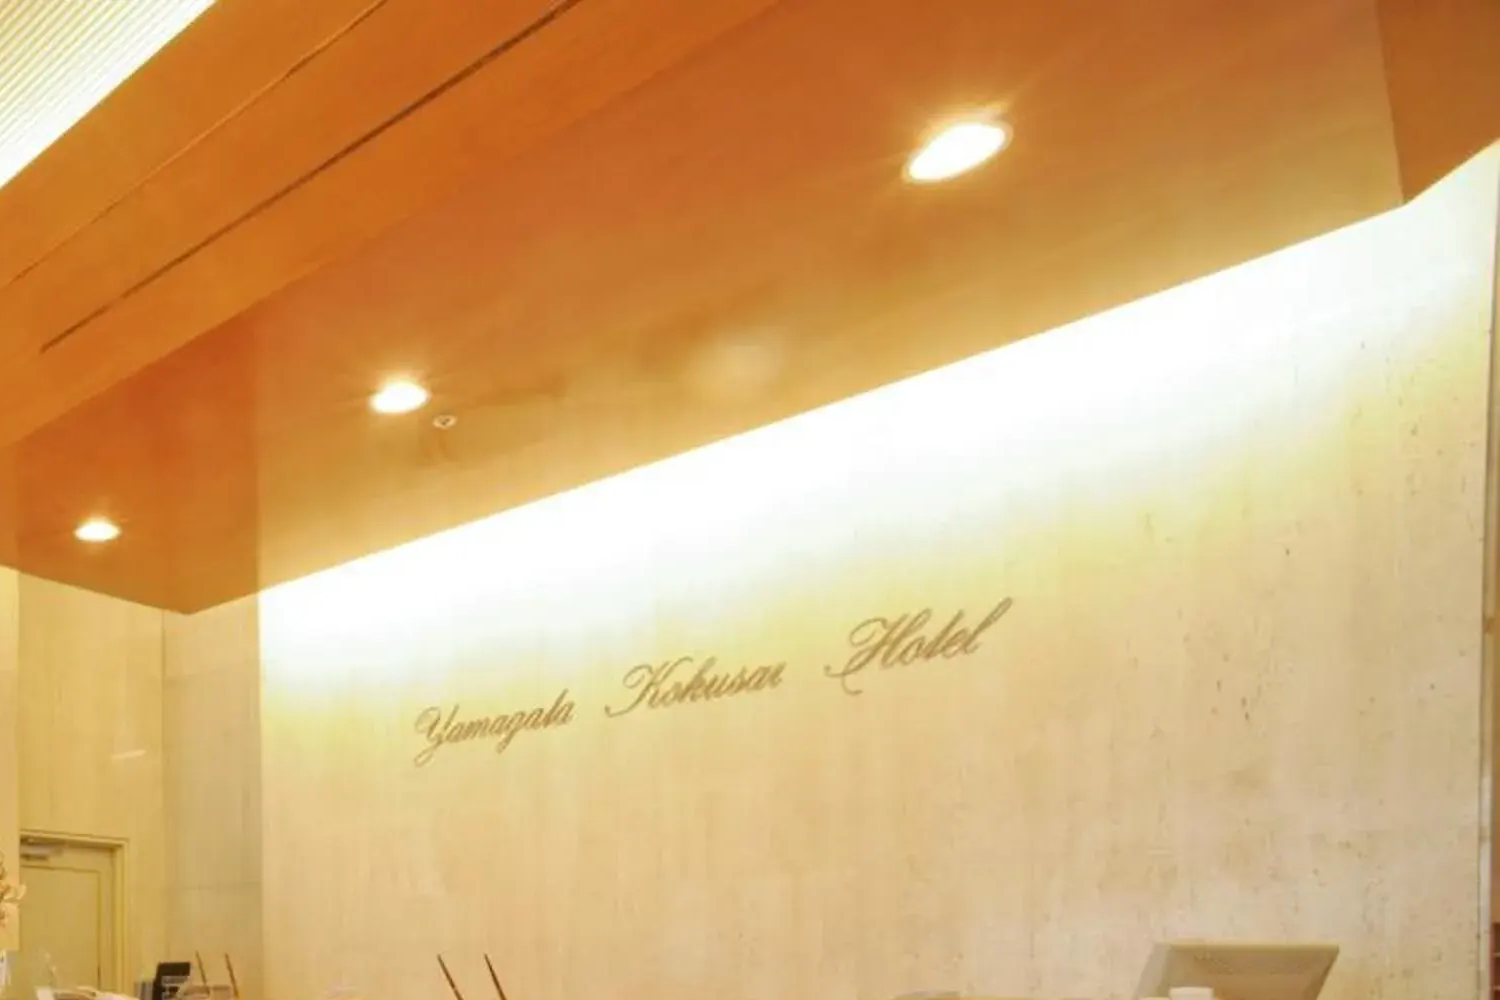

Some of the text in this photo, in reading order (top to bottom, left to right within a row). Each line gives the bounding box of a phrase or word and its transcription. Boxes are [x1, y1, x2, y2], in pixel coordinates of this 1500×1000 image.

[413, 596, 1013, 768] Yamagata Kokusai Hotel
